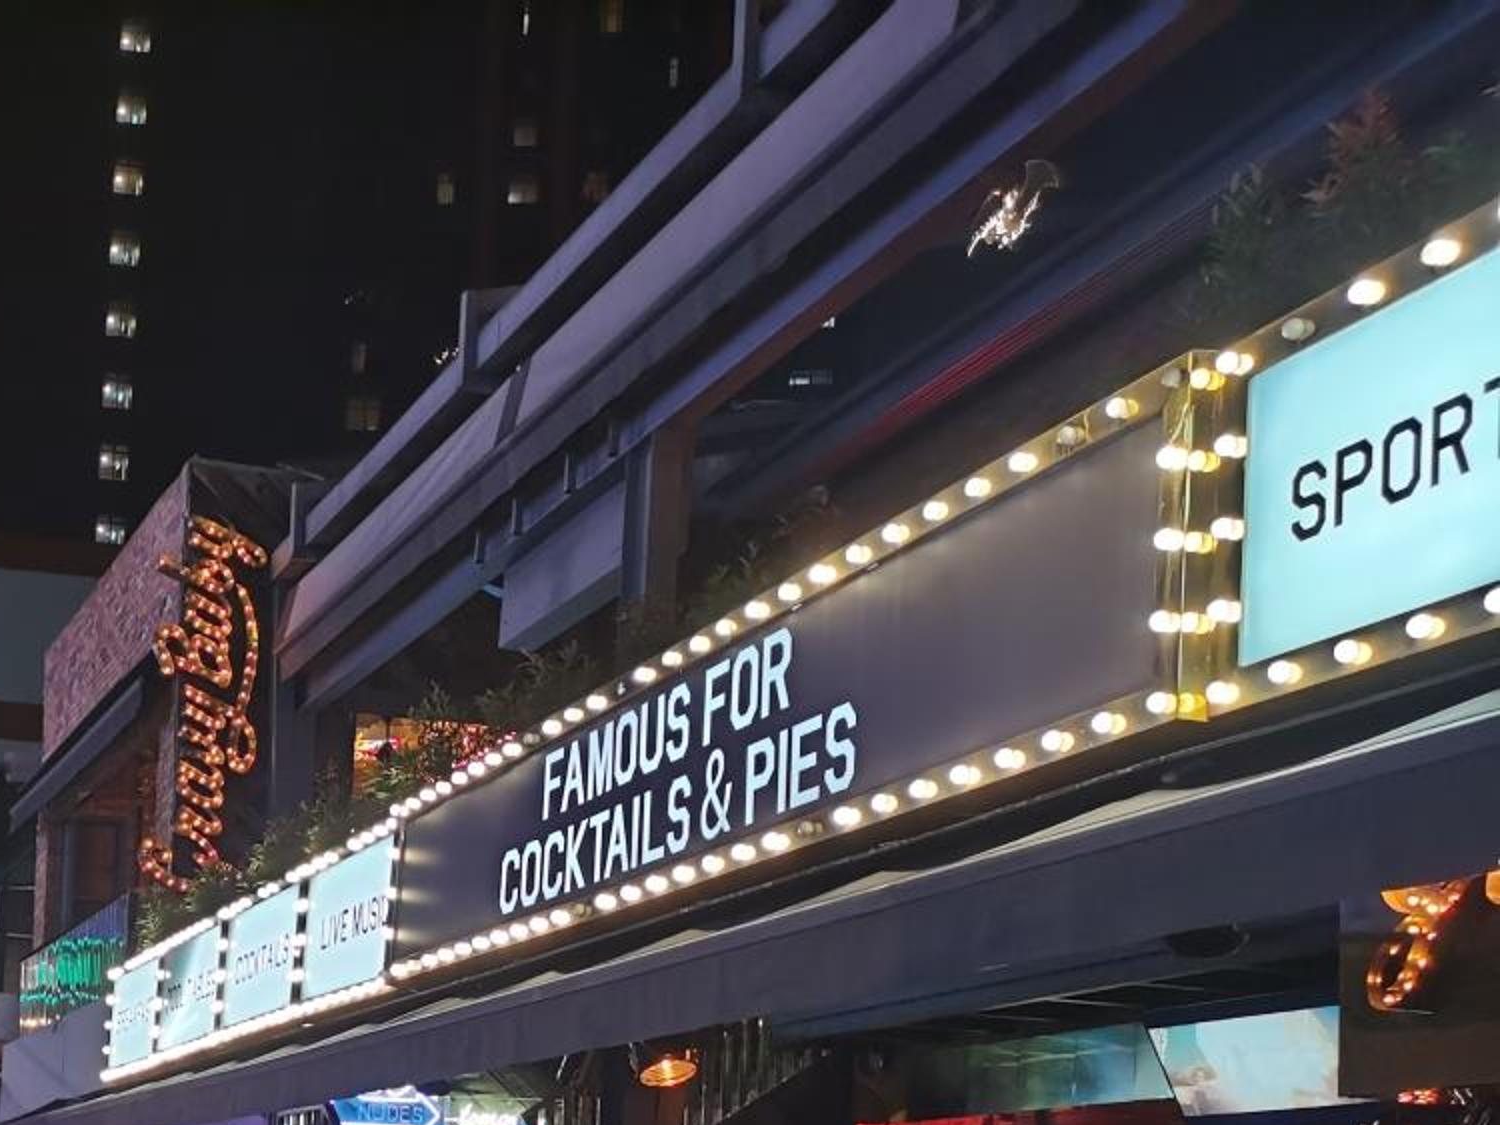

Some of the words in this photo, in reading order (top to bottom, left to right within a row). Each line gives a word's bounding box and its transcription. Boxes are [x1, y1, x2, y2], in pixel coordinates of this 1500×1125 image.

[541, 681, 692, 821] FAMOUS
[702, 626, 793, 747] FOR
[499, 775, 692, 916] COCKTAILS
[700, 748, 732, 841] &
[744, 702, 858, 826] PIES
[320, 909, 350, 950] LIVE
[357, 1102, 424, 1123] NUDES
